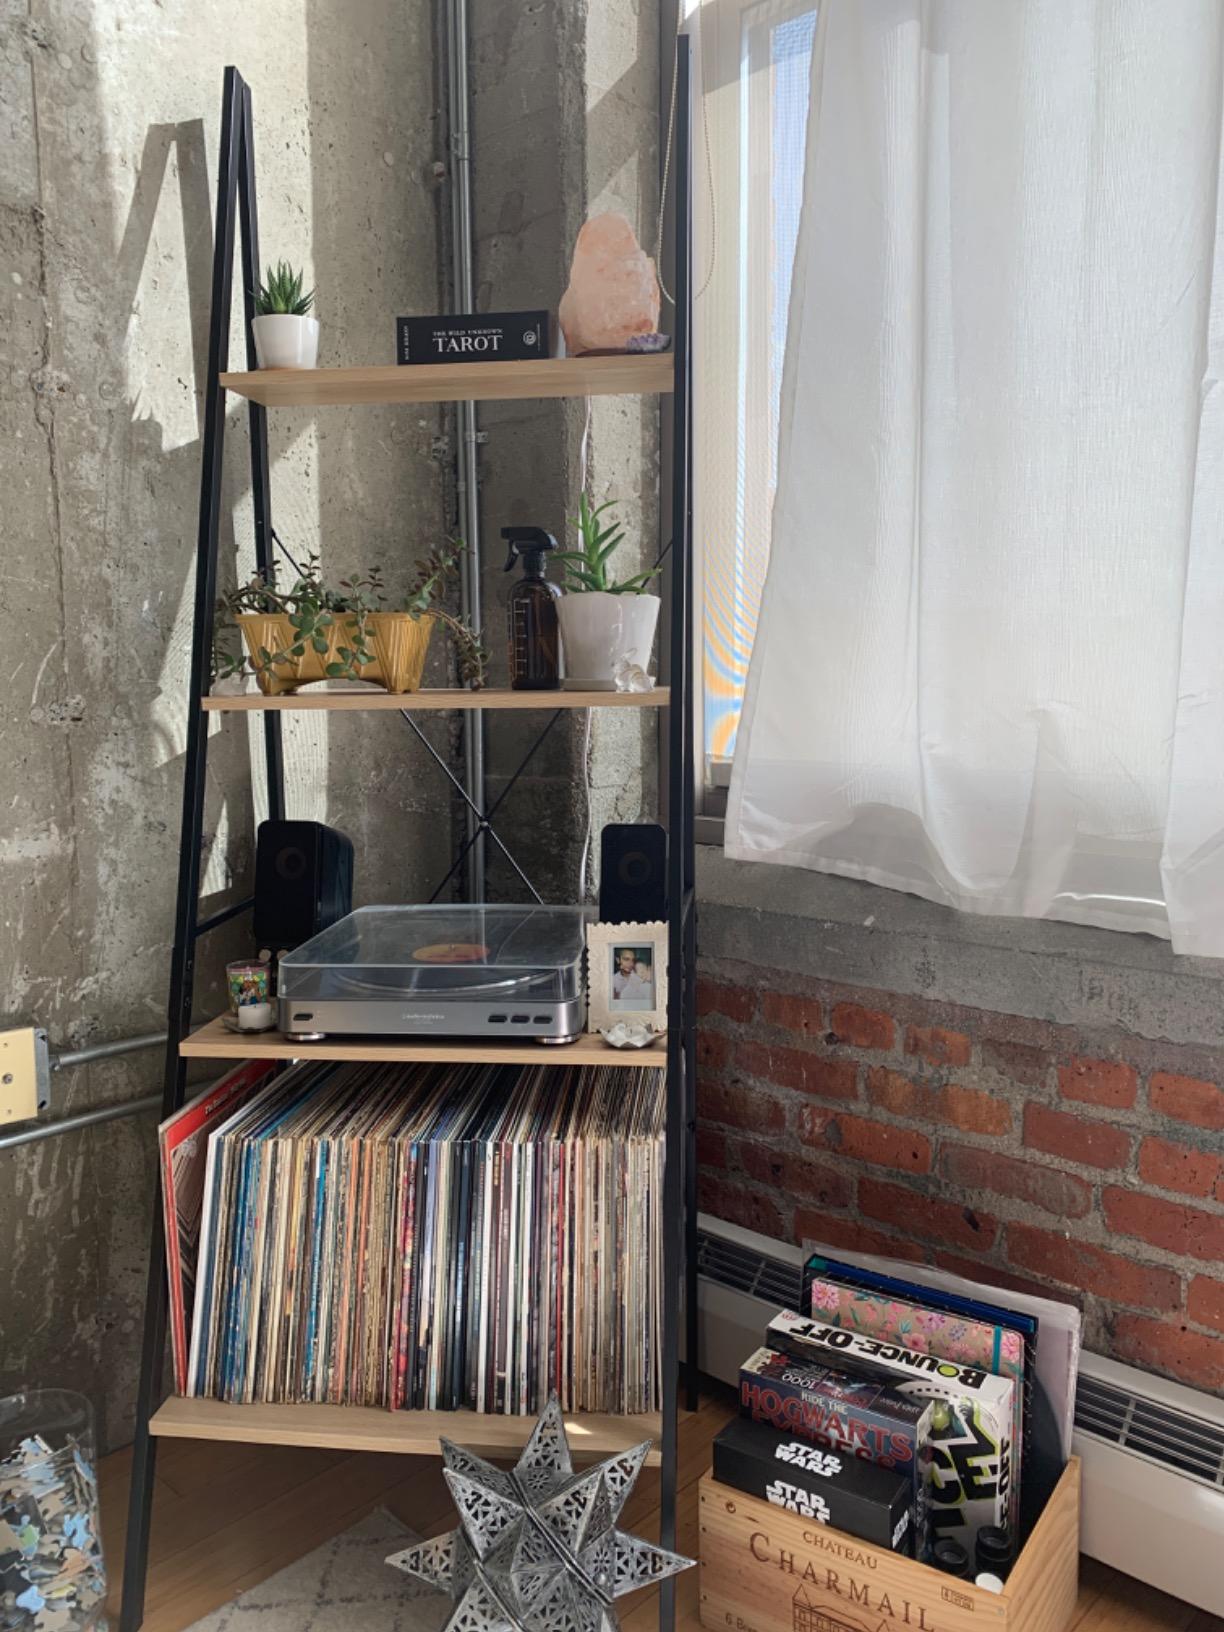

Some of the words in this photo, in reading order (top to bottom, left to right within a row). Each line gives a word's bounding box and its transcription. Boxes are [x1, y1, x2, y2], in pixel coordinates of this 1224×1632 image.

[432, 335, 503, 352] TAROT
[789, 1323, 987, 1389] BOUNCE-OFF
[741, 1380, 913, 1462] HOGWARTS
[774, 1448, 842, 1477] WARS
[776, 1442, 842, 1468] STAR
[766, 1480, 830, 1514] STAR
[803, 1530, 878, 1569] CHATEAU
[750, 1532, 935, 1632] CHARMAIL
